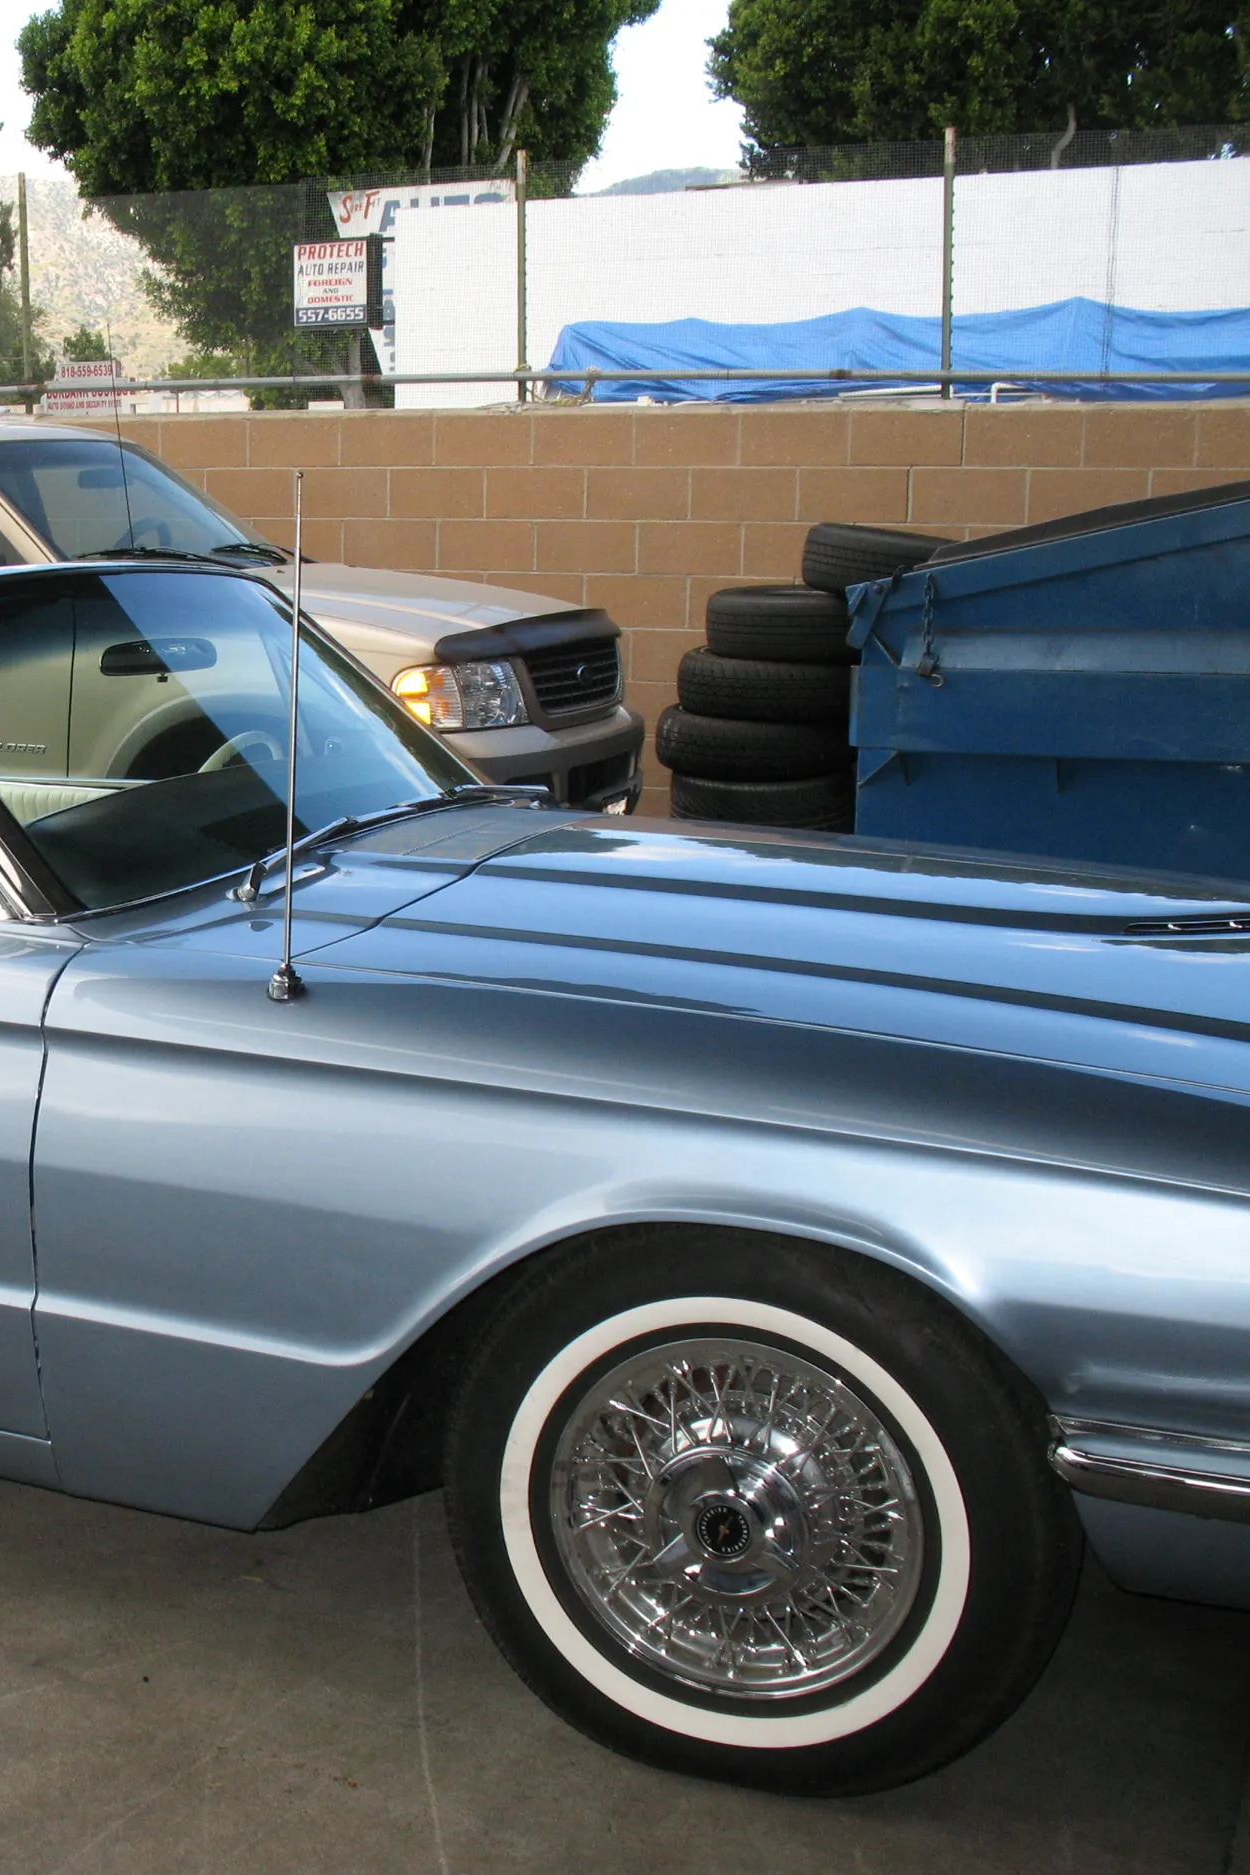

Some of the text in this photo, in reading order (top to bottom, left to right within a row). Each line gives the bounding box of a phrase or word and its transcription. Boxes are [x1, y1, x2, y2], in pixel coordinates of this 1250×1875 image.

[297, 241, 364, 261] PROTECH
[298, 261, 365, 277] AUTO REPAIR
[307, 278, 353, 288] FOREIGN
[323, 287, 339, 295] AND
[307, 295, 354, 305] DOMESTIC
[298, 306, 364, 323] 557-6655
[61, 364, 113, 379] 818-559-6539
